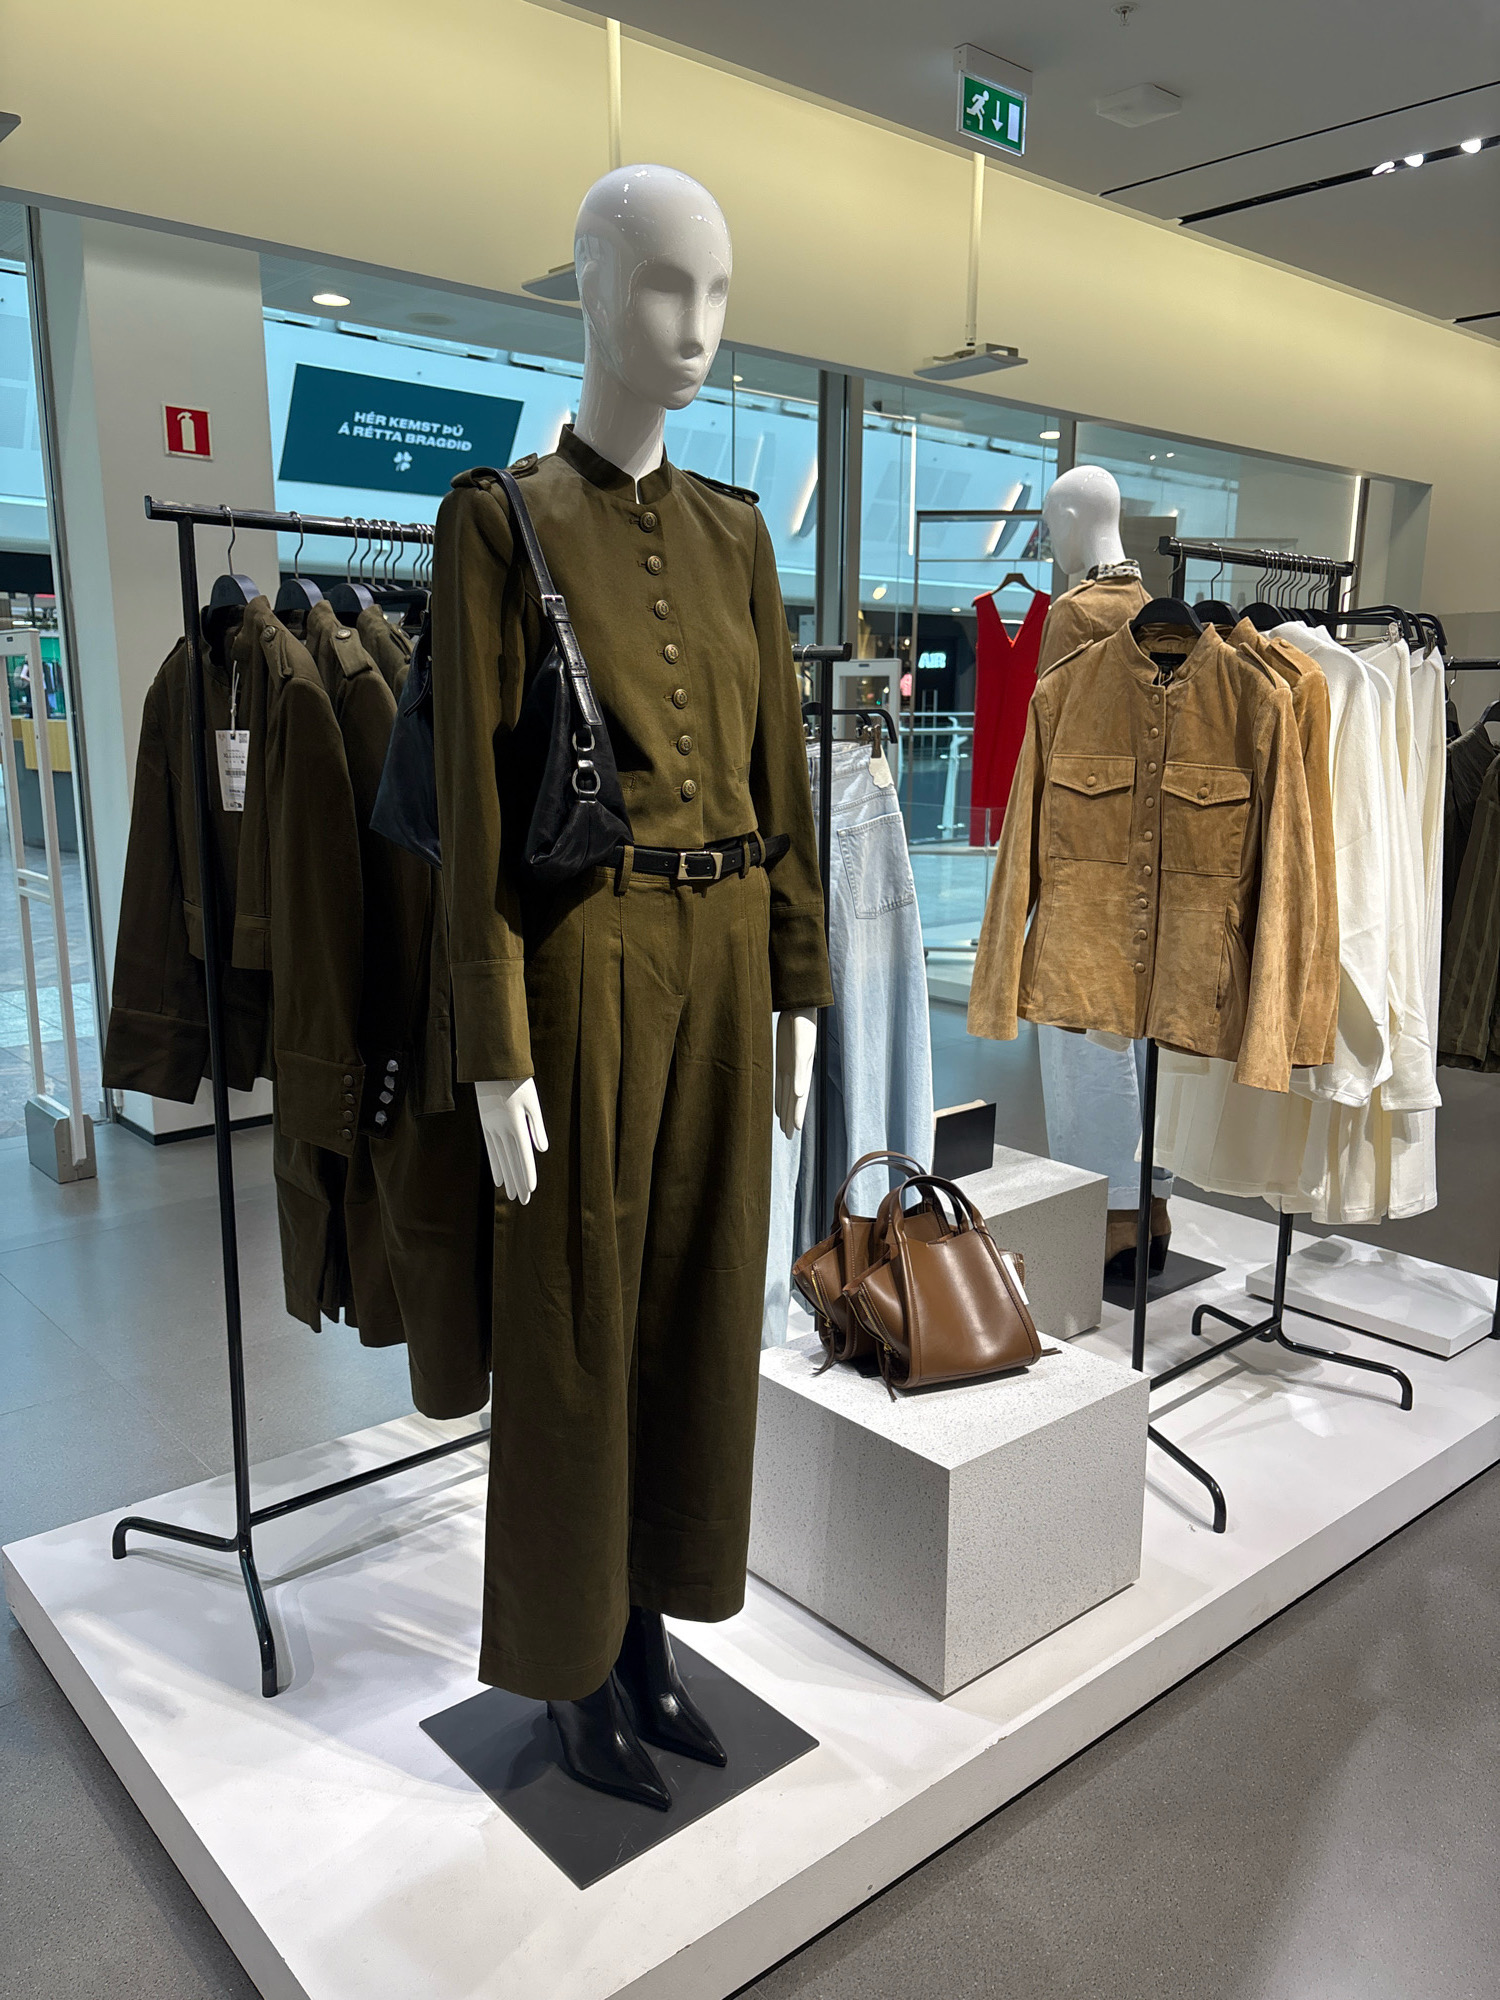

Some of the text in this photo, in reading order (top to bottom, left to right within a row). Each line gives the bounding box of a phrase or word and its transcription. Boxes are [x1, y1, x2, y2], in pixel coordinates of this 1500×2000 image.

[337, 422, 473, 452] Á RÉTTA BRAGÐIÐ
[354, 411, 464, 437] HÉR KEMST ÞÚ
